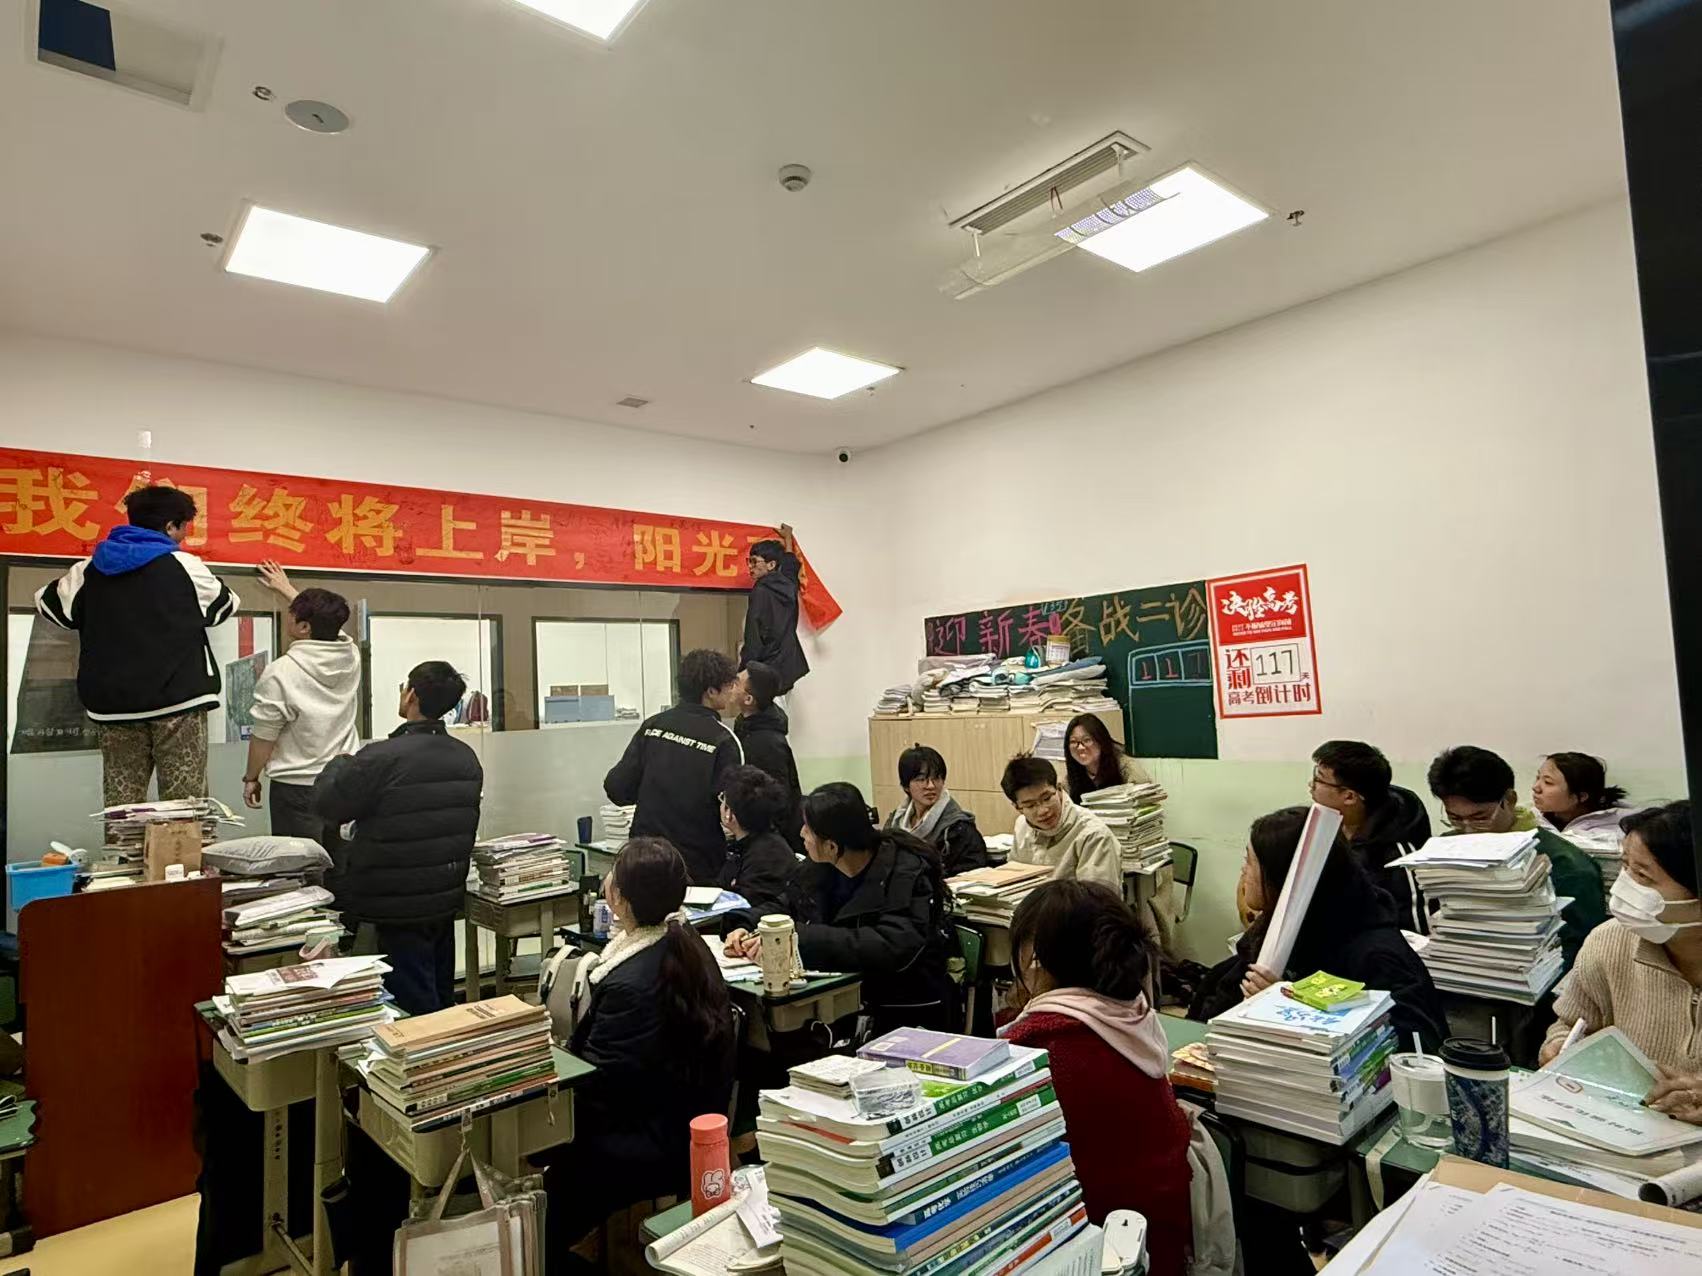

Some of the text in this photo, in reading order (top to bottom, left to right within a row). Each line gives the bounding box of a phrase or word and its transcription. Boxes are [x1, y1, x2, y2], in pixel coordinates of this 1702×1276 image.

[0, 466, 783, 578] 我们终将上岸，阳光
[1221, 586, 1299, 620] 决胜高考
[1225, 648, 1251, 690] 还剩
[1255, 649, 1294, 677] 117
[1228, 682, 1311, 706] 高考倒计时
[662, 731, 697, 747] AGAINST
[696, 741, 717, 754] TIME
